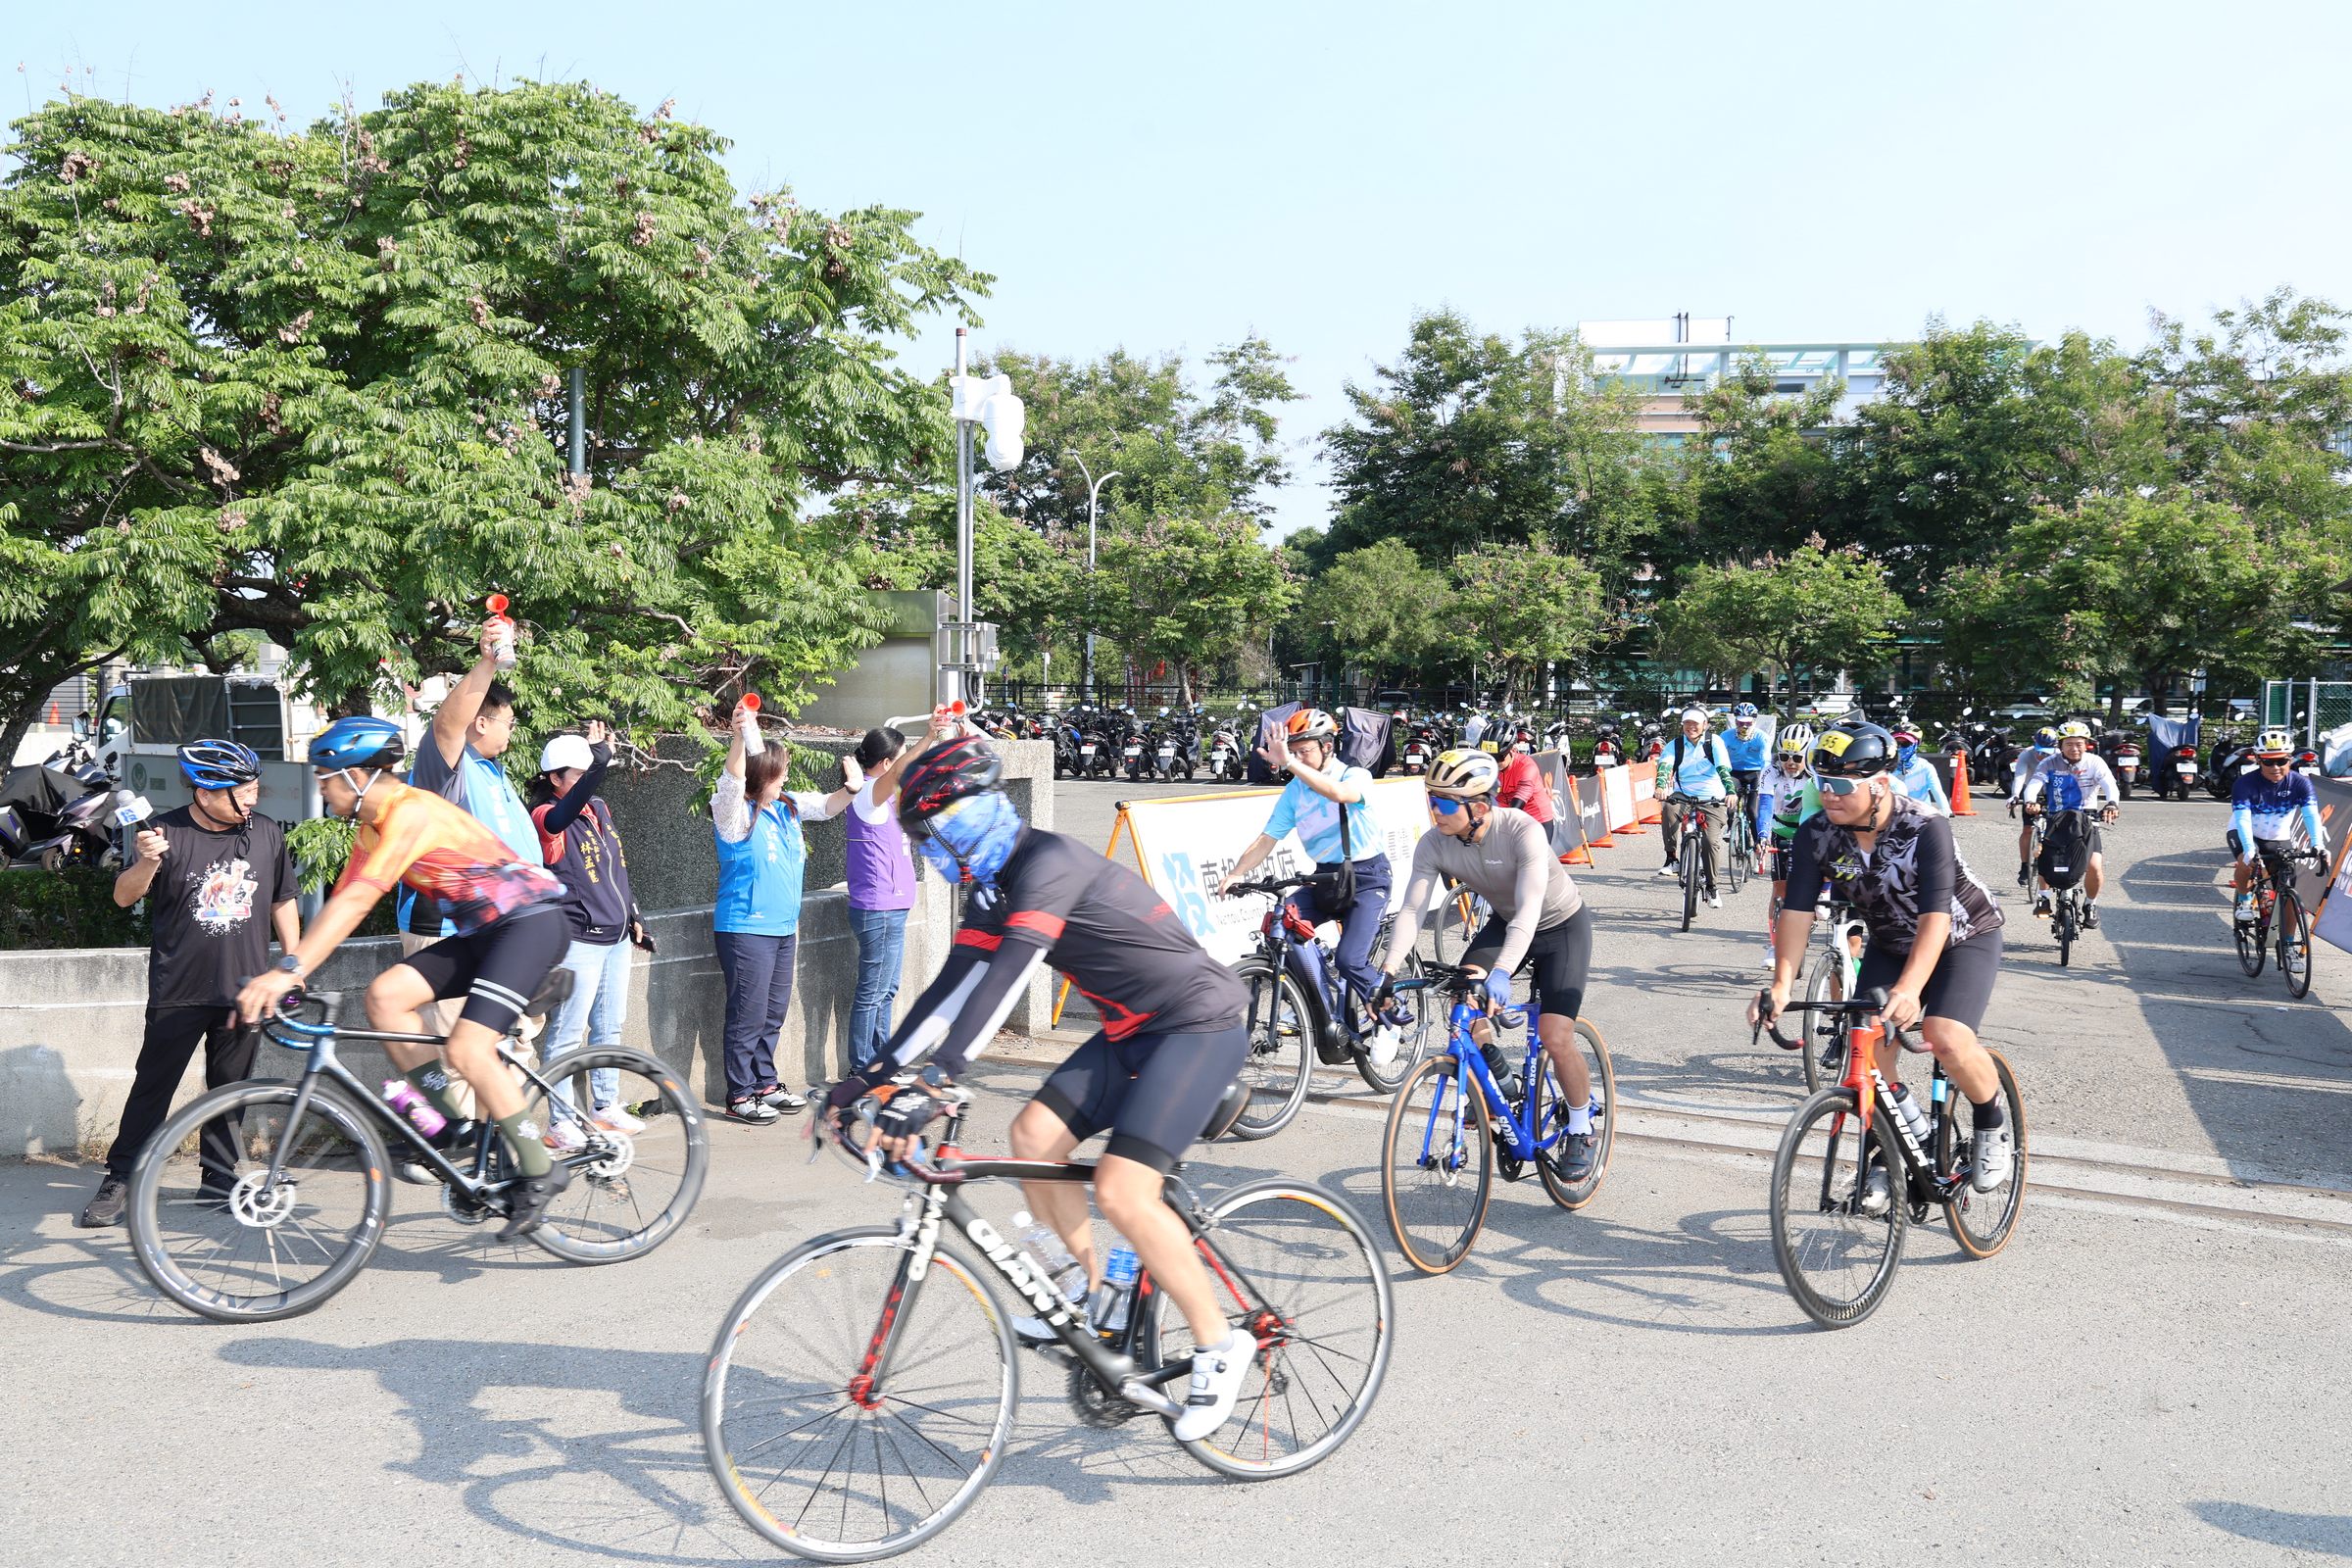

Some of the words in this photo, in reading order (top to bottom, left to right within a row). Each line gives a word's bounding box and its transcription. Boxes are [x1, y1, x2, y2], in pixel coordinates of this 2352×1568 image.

[1822, 735, 1838, 749] 55
[1529, 1056, 1538, 1087] GIOS
[1498, 1115, 1520, 1147] GIOS
[1869, 1068, 1930, 1167] MERIDA
[966, 1218, 1071, 1327] GIANT
